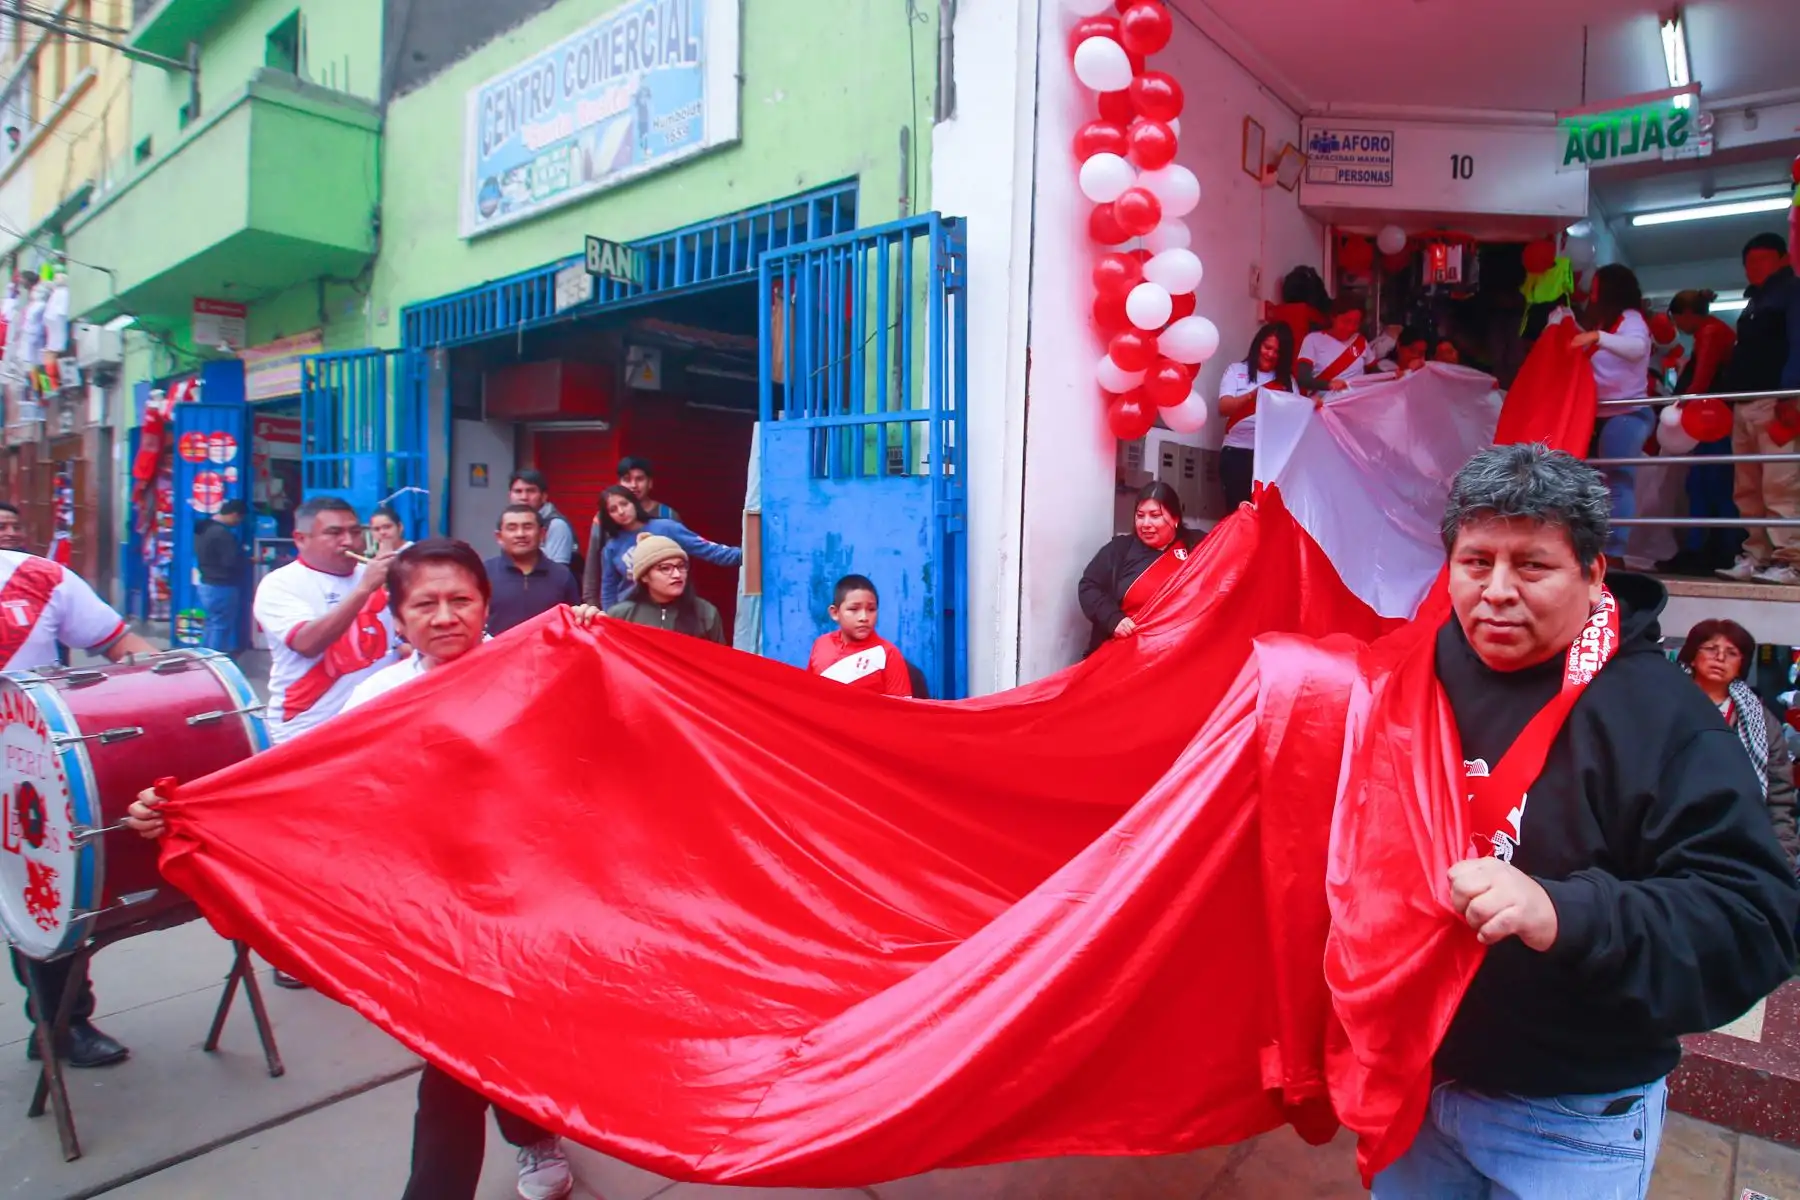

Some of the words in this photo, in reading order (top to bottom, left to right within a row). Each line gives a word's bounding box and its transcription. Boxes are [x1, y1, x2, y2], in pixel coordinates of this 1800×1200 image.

[482, 60, 556, 157] CENTRO
[562, 0, 698, 99] COMERCIAL
[1342, 135, 1390, 152] AFORO
[1308, 153, 1355, 162] CAPACIDAD
[1450, 154, 1474, 180] 10
[1338, 169, 1390, 183] PERSONAS
